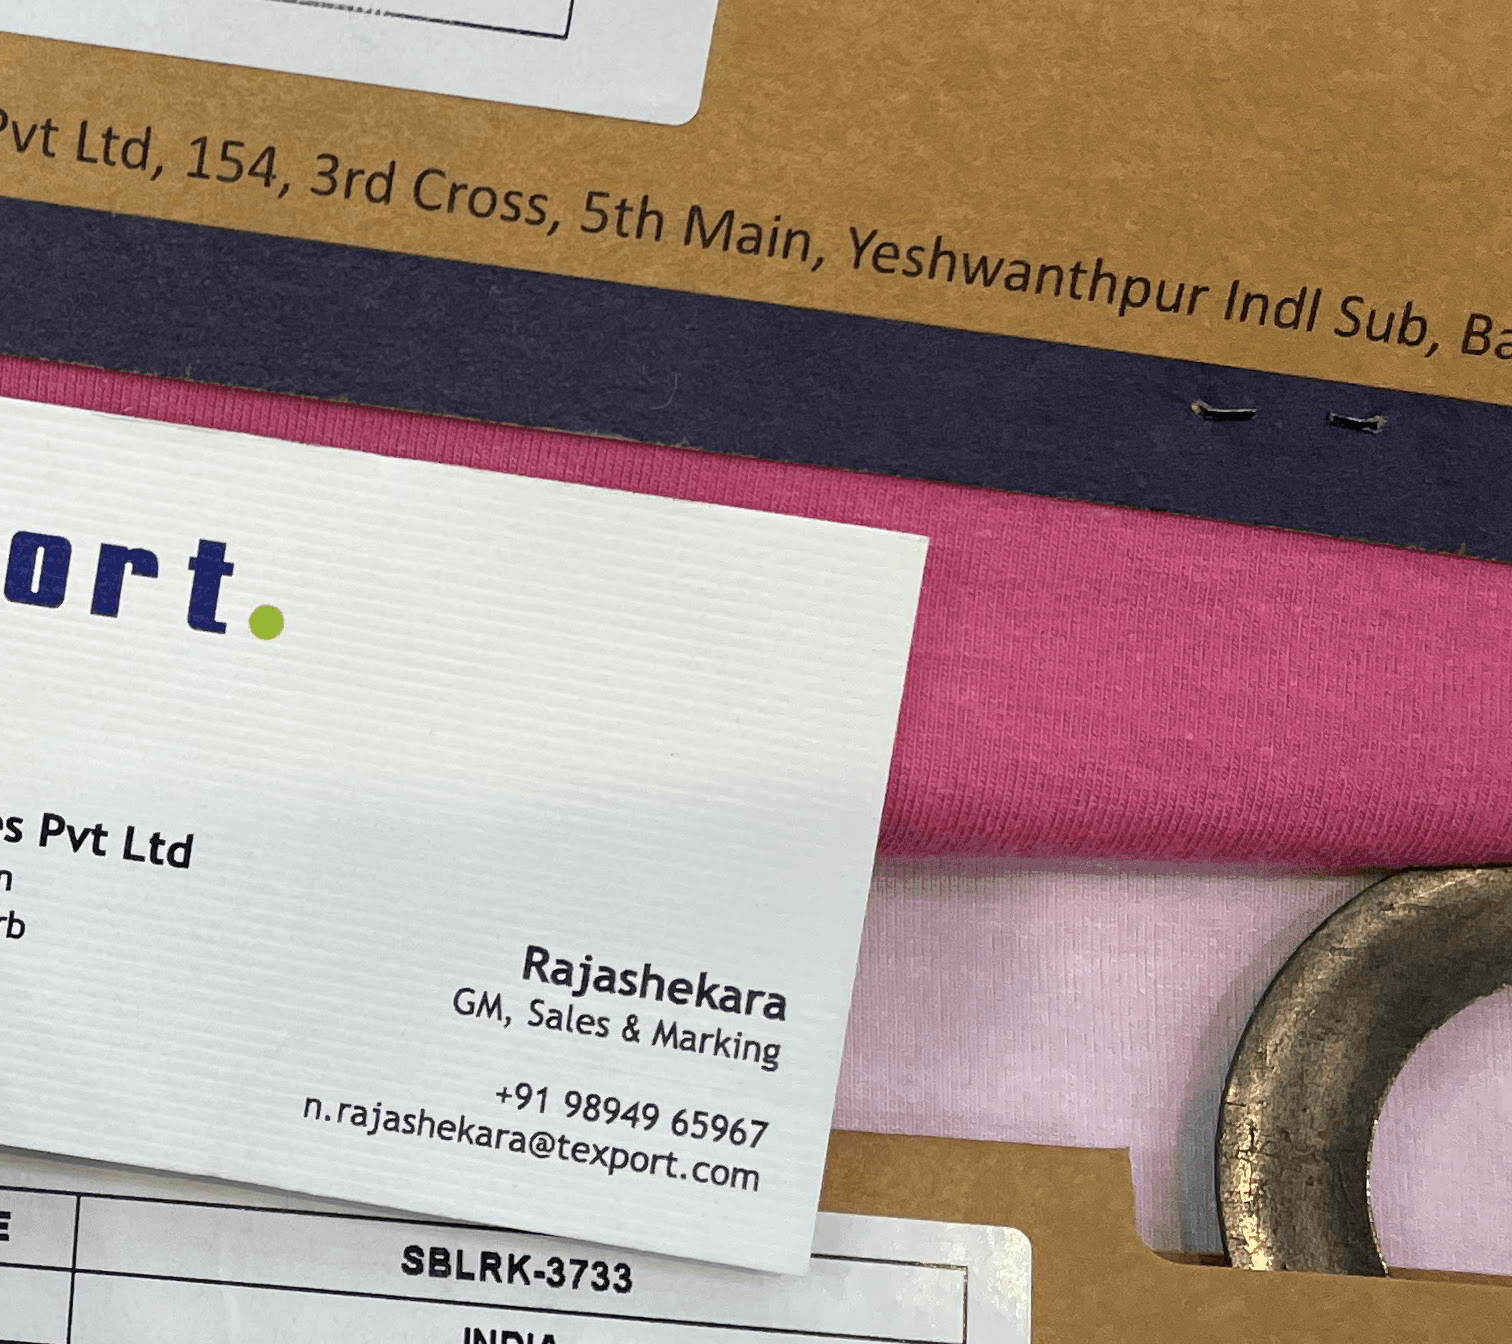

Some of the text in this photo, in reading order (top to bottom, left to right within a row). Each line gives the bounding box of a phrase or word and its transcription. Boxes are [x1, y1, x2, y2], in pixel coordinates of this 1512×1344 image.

[77, 120, 162, 181] Ltd,
[187, 136, 290, 199] 154,
[310, 154, 396, 205] 3rd
[414, 168, 560, 236] Cross,
[581, 191, 663, 241] 5th
[684, 205, 824, 272] Main,
[850, 227, 1210, 317] Yeshwanthpur
[1225, 280, 1322, 331] Indl
[1334, 296, 1439, 357] Sub,
[39, 813, 108, 856] Pvt
[123, 826, 194, 869] Ltd
[523, 945, 786, 1021] Rajashekara
[454, 988, 781, 1071] GM, Sales & Marking
[304, 1095, 759, 1191] n.rajashekara@texport.com
[496, 1083, 769, 1148] +91 98949 65967
[401, 1245, 632, 1293] SBLRK-3733
